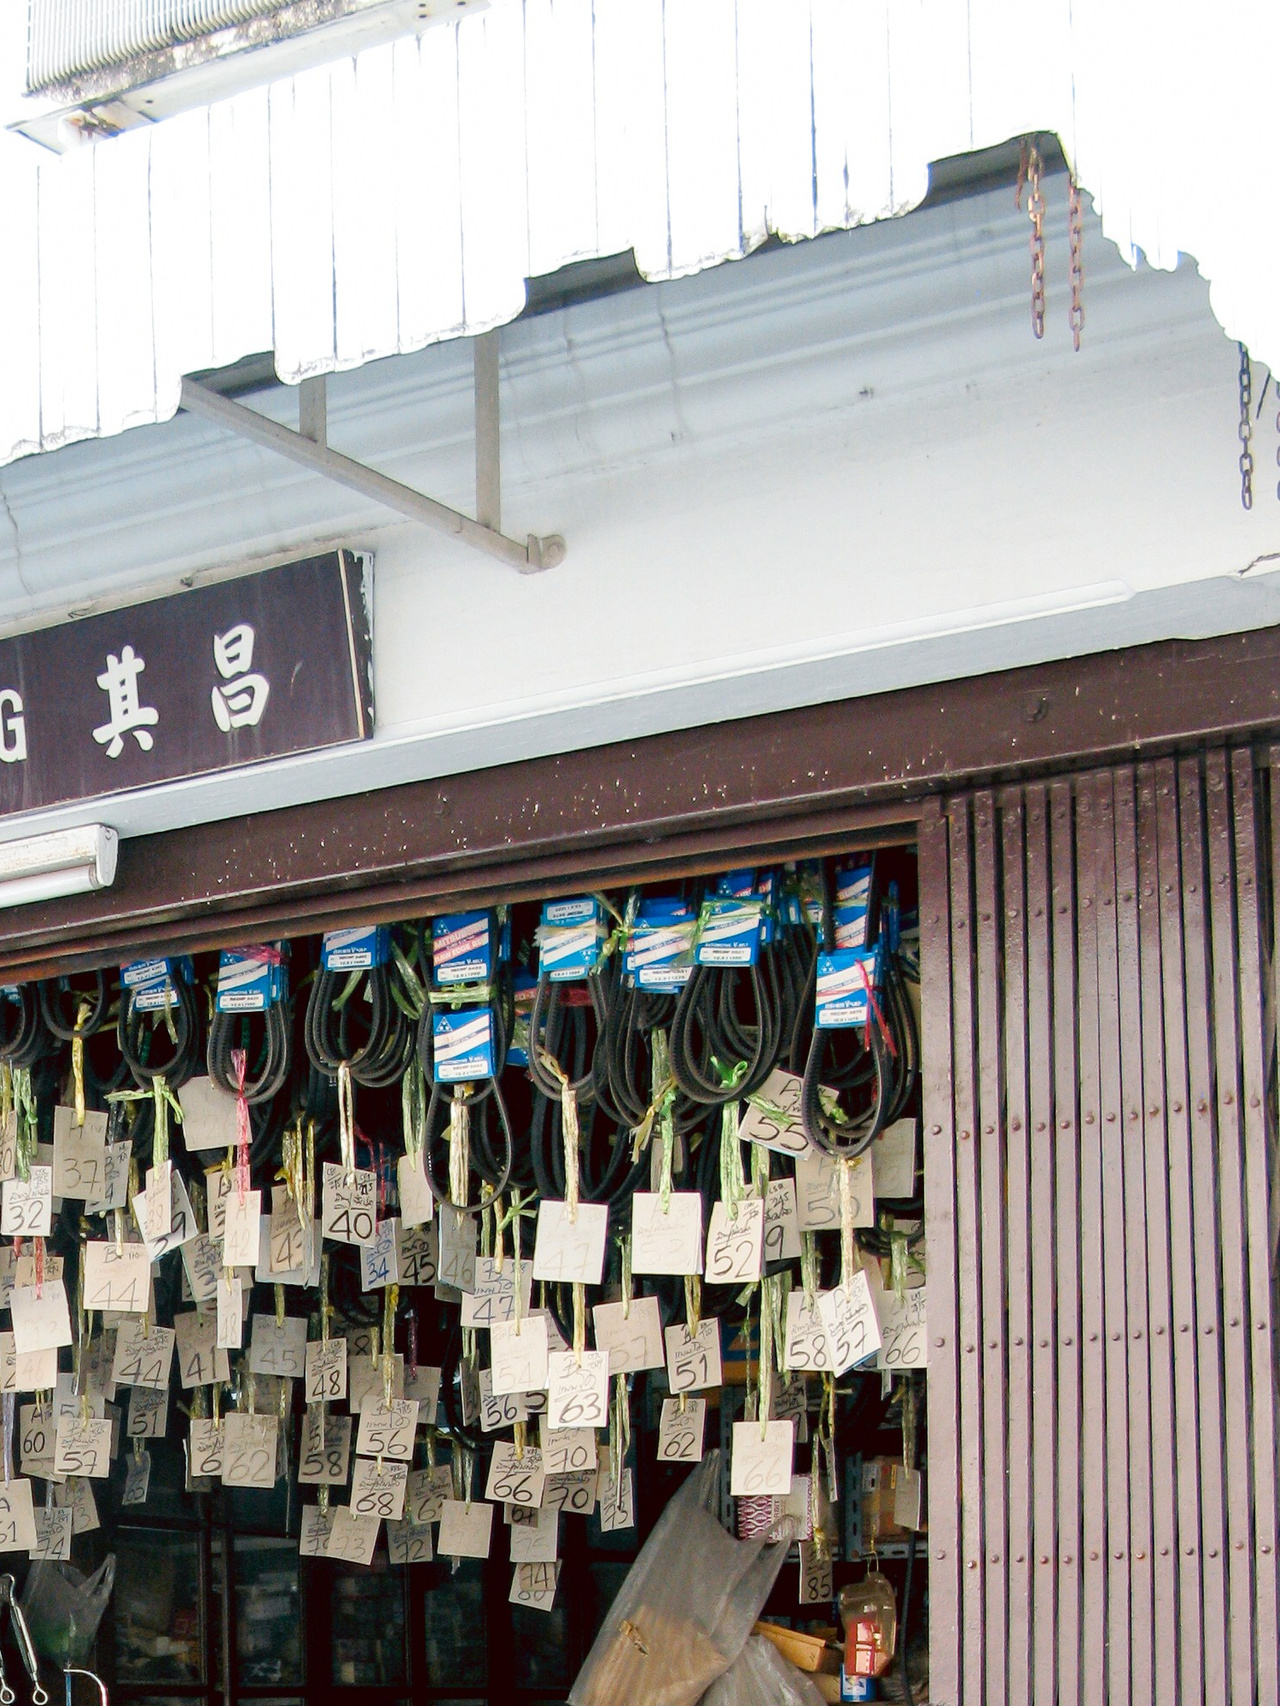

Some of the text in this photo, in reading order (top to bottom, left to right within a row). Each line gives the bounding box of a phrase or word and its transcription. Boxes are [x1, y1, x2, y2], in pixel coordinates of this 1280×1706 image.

[749, 1115, 809, 1152] 55
[63, 1157, 98, 1194] 37
[8, 1199, 44, 1233] 32
[328, 1210, 373, 1241] 40
[368, 1257, 390, 1284] 34
[403, 1253, 437, 1285] 45
[538, 1242, 593, 1279] 47
[713, 1240, 754, 1279] 52
[90, 1277, 142, 1312] 44
[472, 1295, 515, 1325] 47
[608, 1335, 647, 1369] 57
[787, 1334, 827, 1369] 58
[836, 1320, 867, 1367] 57
[884, 1331, 921, 1365] 66
[119, 1357, 163, 1388] 44
[185, 1347, 219, 1382] 41
[259, 1349, 298, 1373] 45
[498, 1361, 534, 1392] 54
[675, 1355, 708, 1391] 51
[311, 1369, 341, 1400] 48
[486, 1397, 518, 1426] 56
[559, 1391, 602, 1424] 63
[131, 1412, 158, 1436] 51
[23, 1430, 46, 1454] 60
[365, 1430, 408, 1455] 56
[664, 1431, 696, 1460] 62
[57, 1450, 98, 1474] 57
[227, 1449, 271, 1482] 62
[301, 1451, 344, 1478] 58
[549, 1445, 588, 1472] 70
[742, 1453, 783, 1492] 66
[493, 1474, 533, 1503] 66
[547, 1485, 590, 1512] 70
[355, 1492, 396, 1517] 68
[521, 1563, 549, 1588] 74
[806, 1573, 833, 1601] 85
